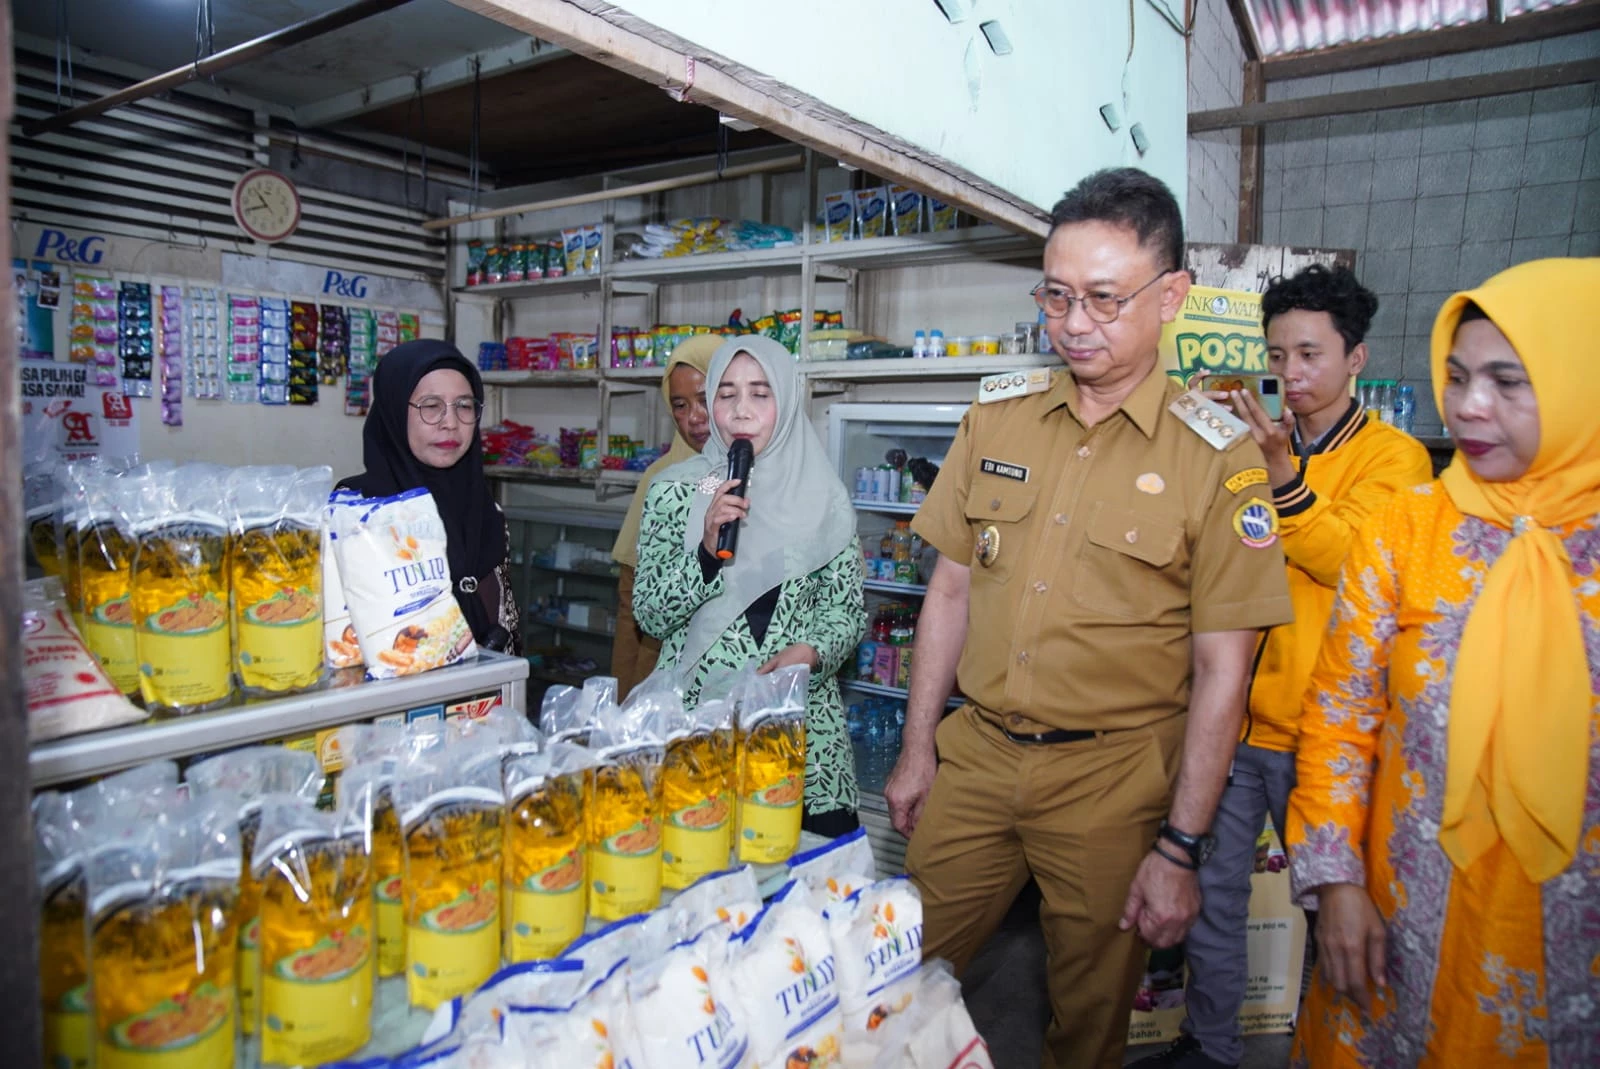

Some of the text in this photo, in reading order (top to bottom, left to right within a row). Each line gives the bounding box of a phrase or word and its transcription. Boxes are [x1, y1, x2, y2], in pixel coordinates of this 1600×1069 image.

[34, 228, 106, 265] P&G
[322, 270, 369, 299] P&G
[40, 368, 72, 382] PILIH
[21, 383, 85, 397] ASA SAMA!
[384, 557, 445, 595] TULIP
